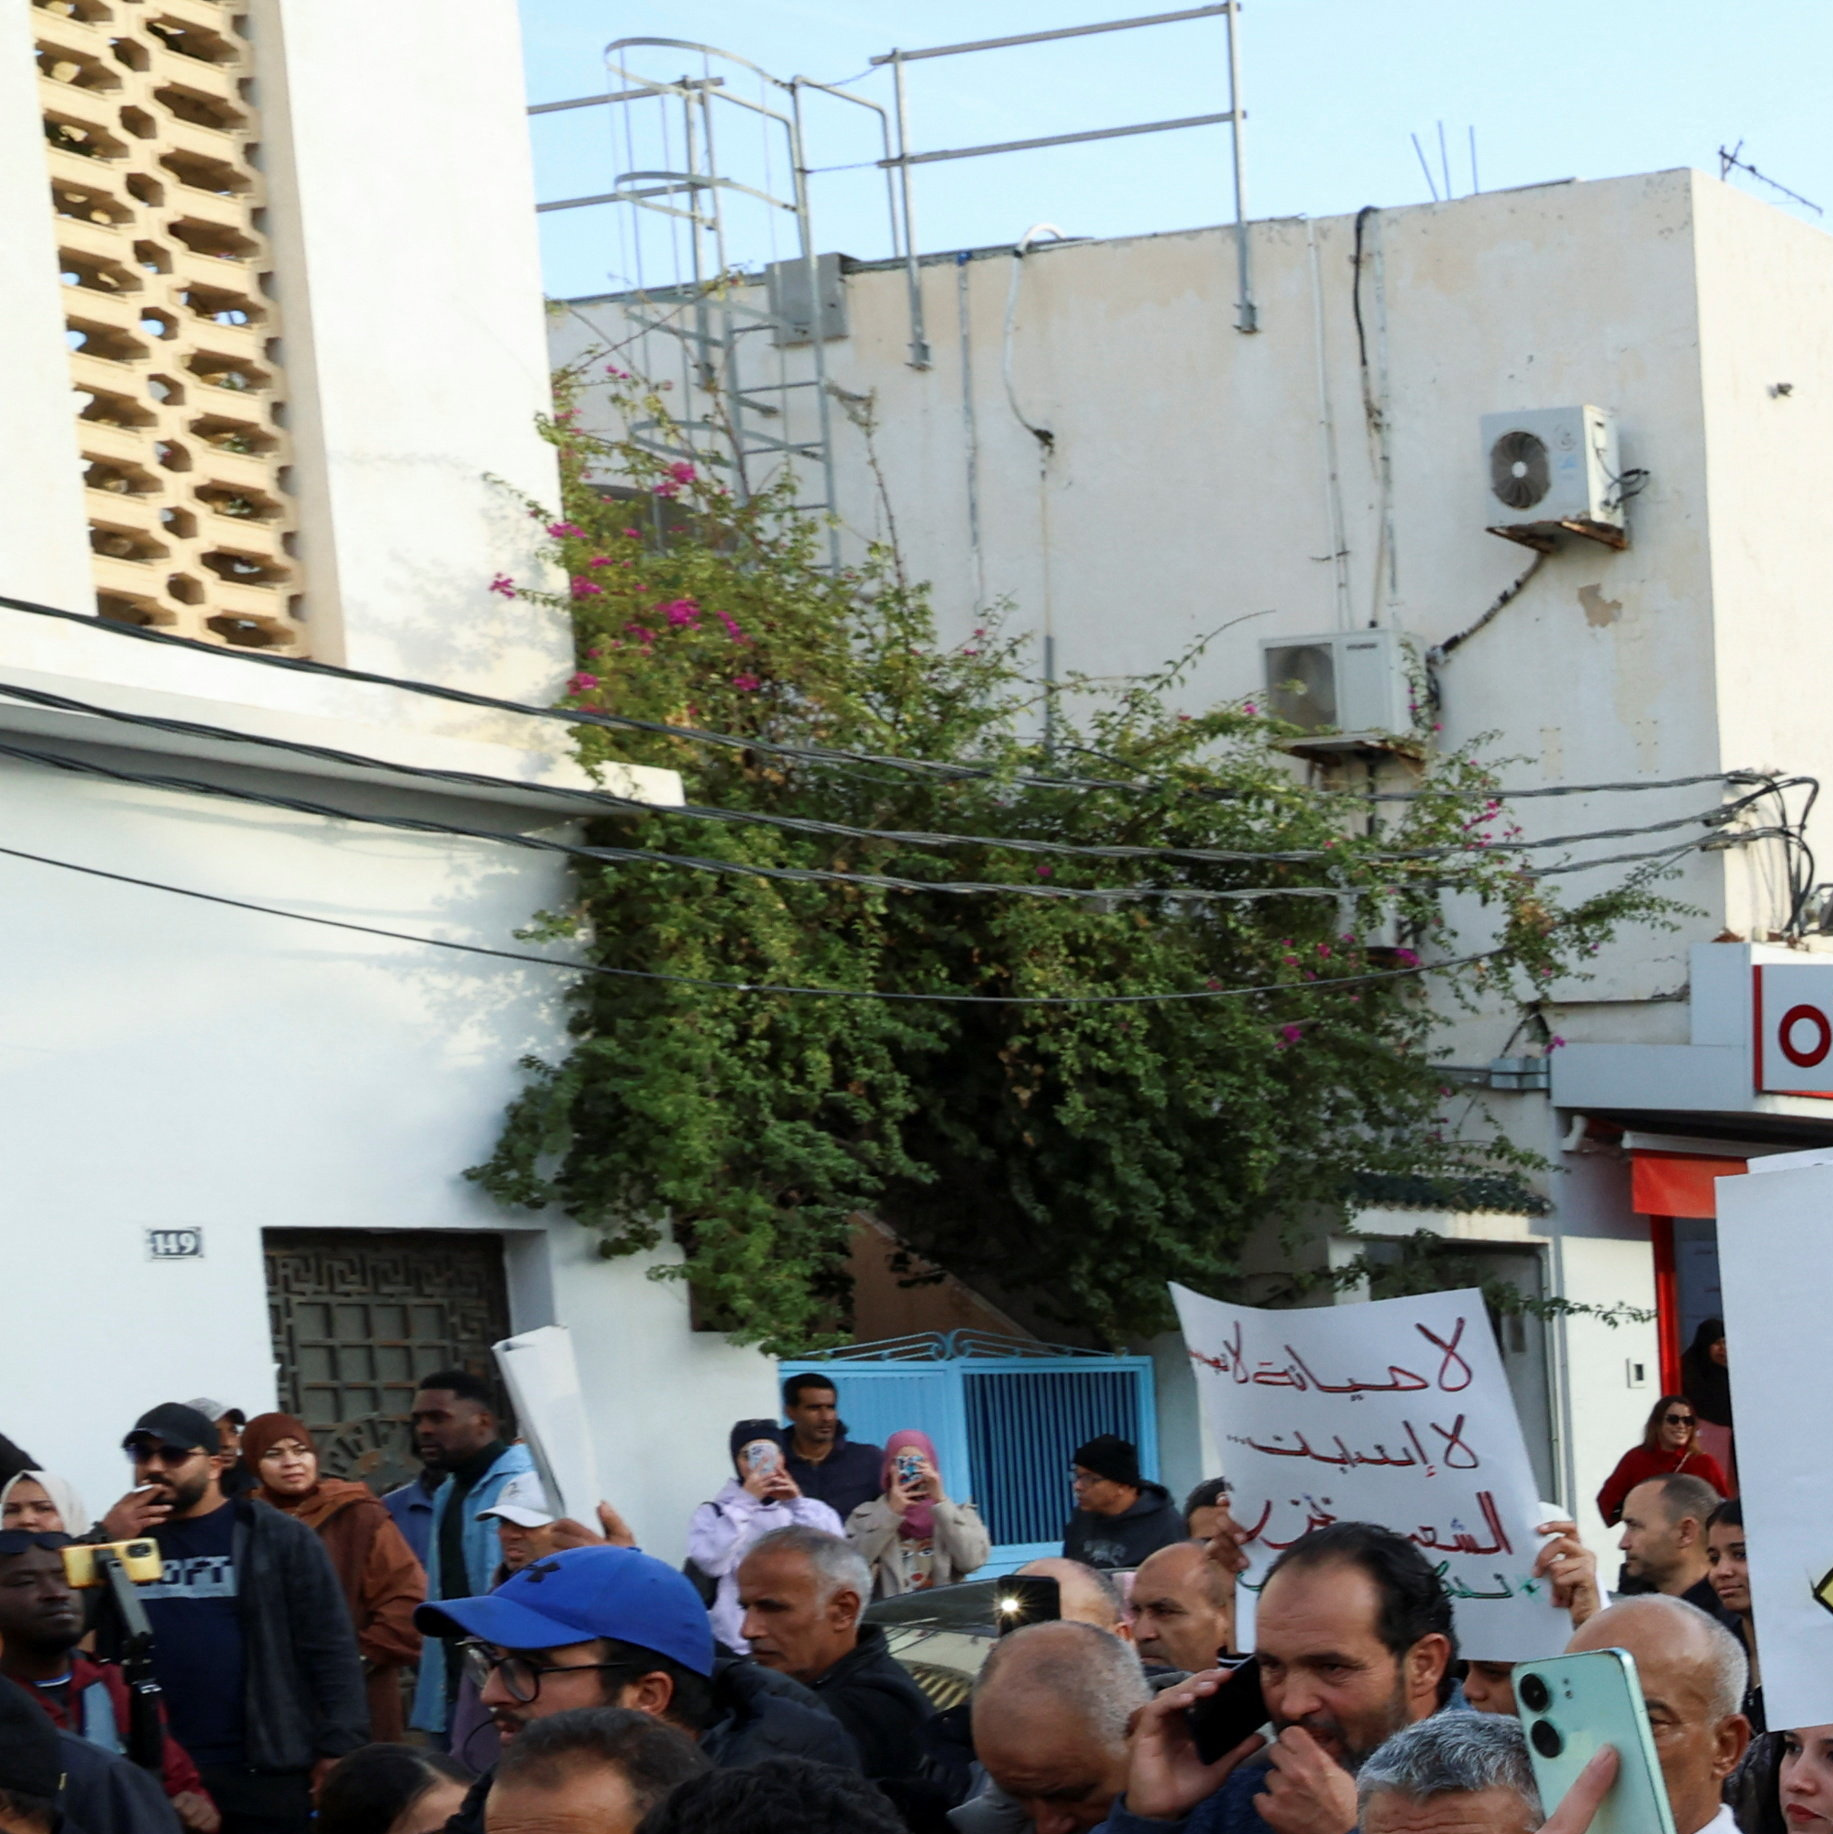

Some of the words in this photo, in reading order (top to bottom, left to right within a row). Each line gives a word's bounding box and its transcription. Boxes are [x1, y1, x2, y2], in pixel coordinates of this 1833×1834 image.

[153, 1232, 197, 1254] 149
[1415, 1317, 1472, 1392] لا
[1429, 1413, 1480, 1469] لا
